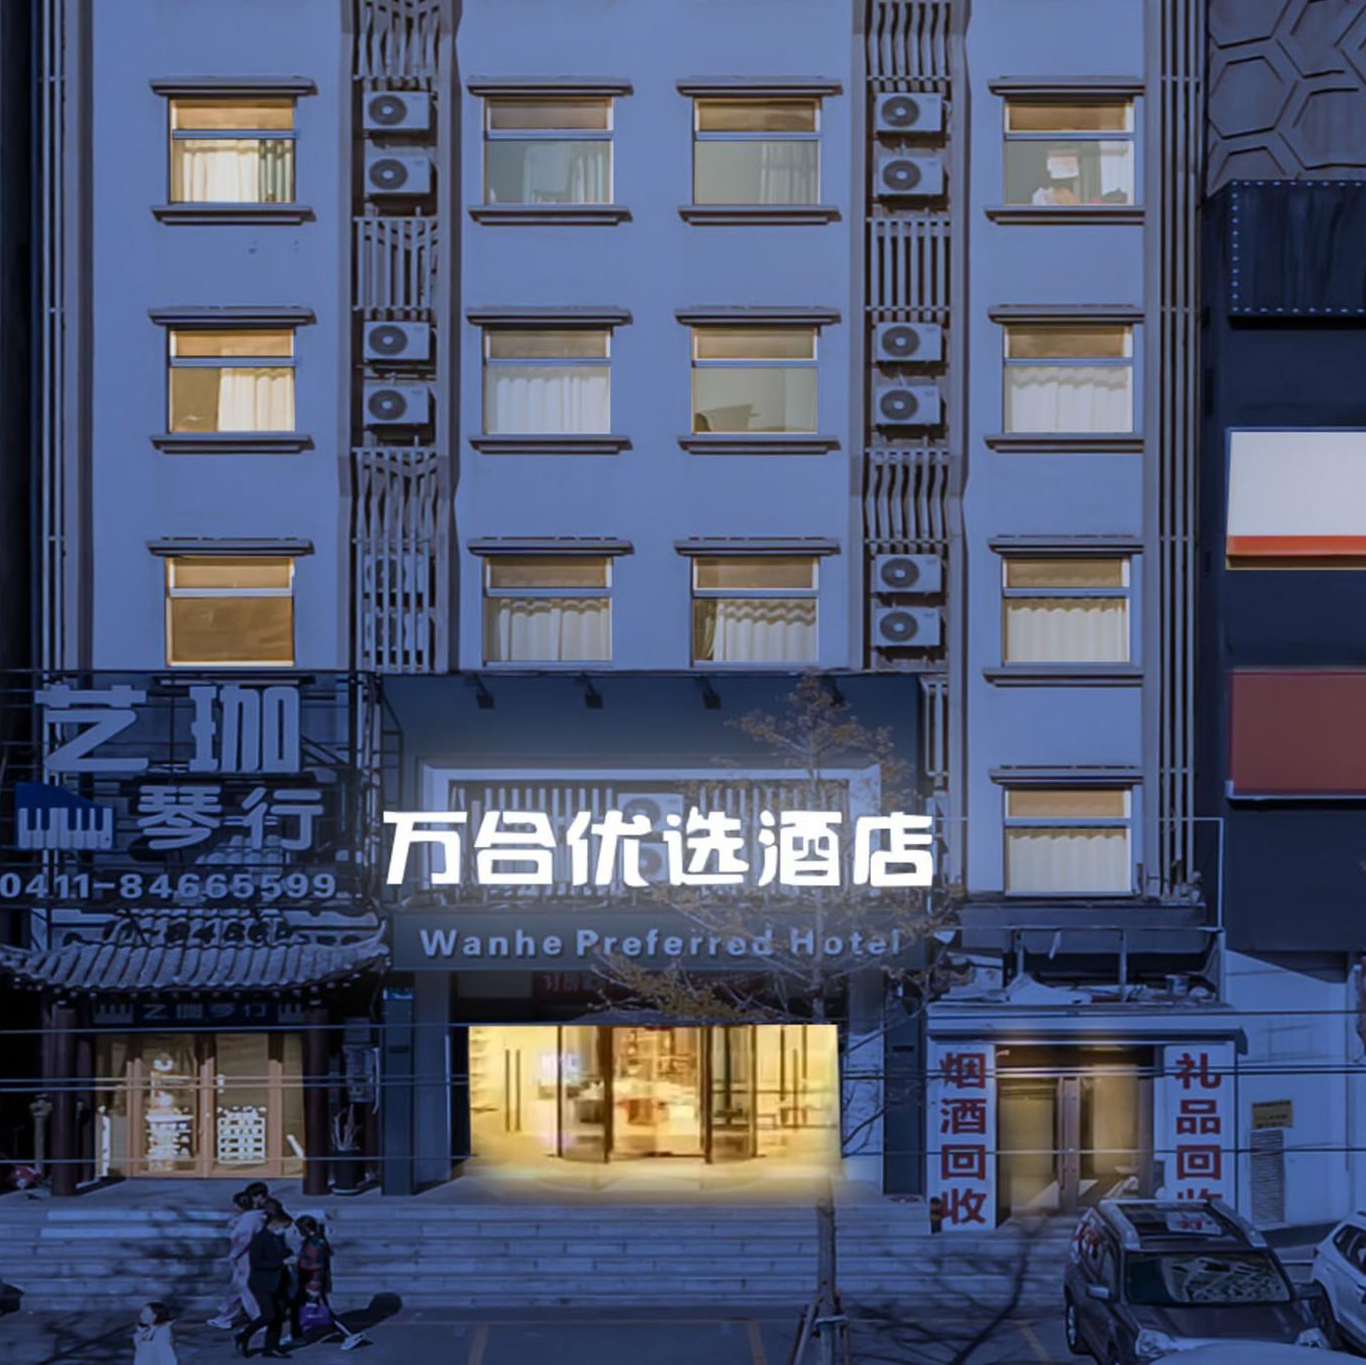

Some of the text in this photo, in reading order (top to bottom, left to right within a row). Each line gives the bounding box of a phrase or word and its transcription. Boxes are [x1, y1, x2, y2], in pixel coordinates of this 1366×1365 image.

[37, 683, 303, 774] 艺珈
[135, 785, 325, 852] 琴行
[381, 807, 934, 888] 万合优选酒店
[419, 927, 902, 957] Wanhe Preferred Hotel
[939, 1050, 988, 1227] 烟酒回收
